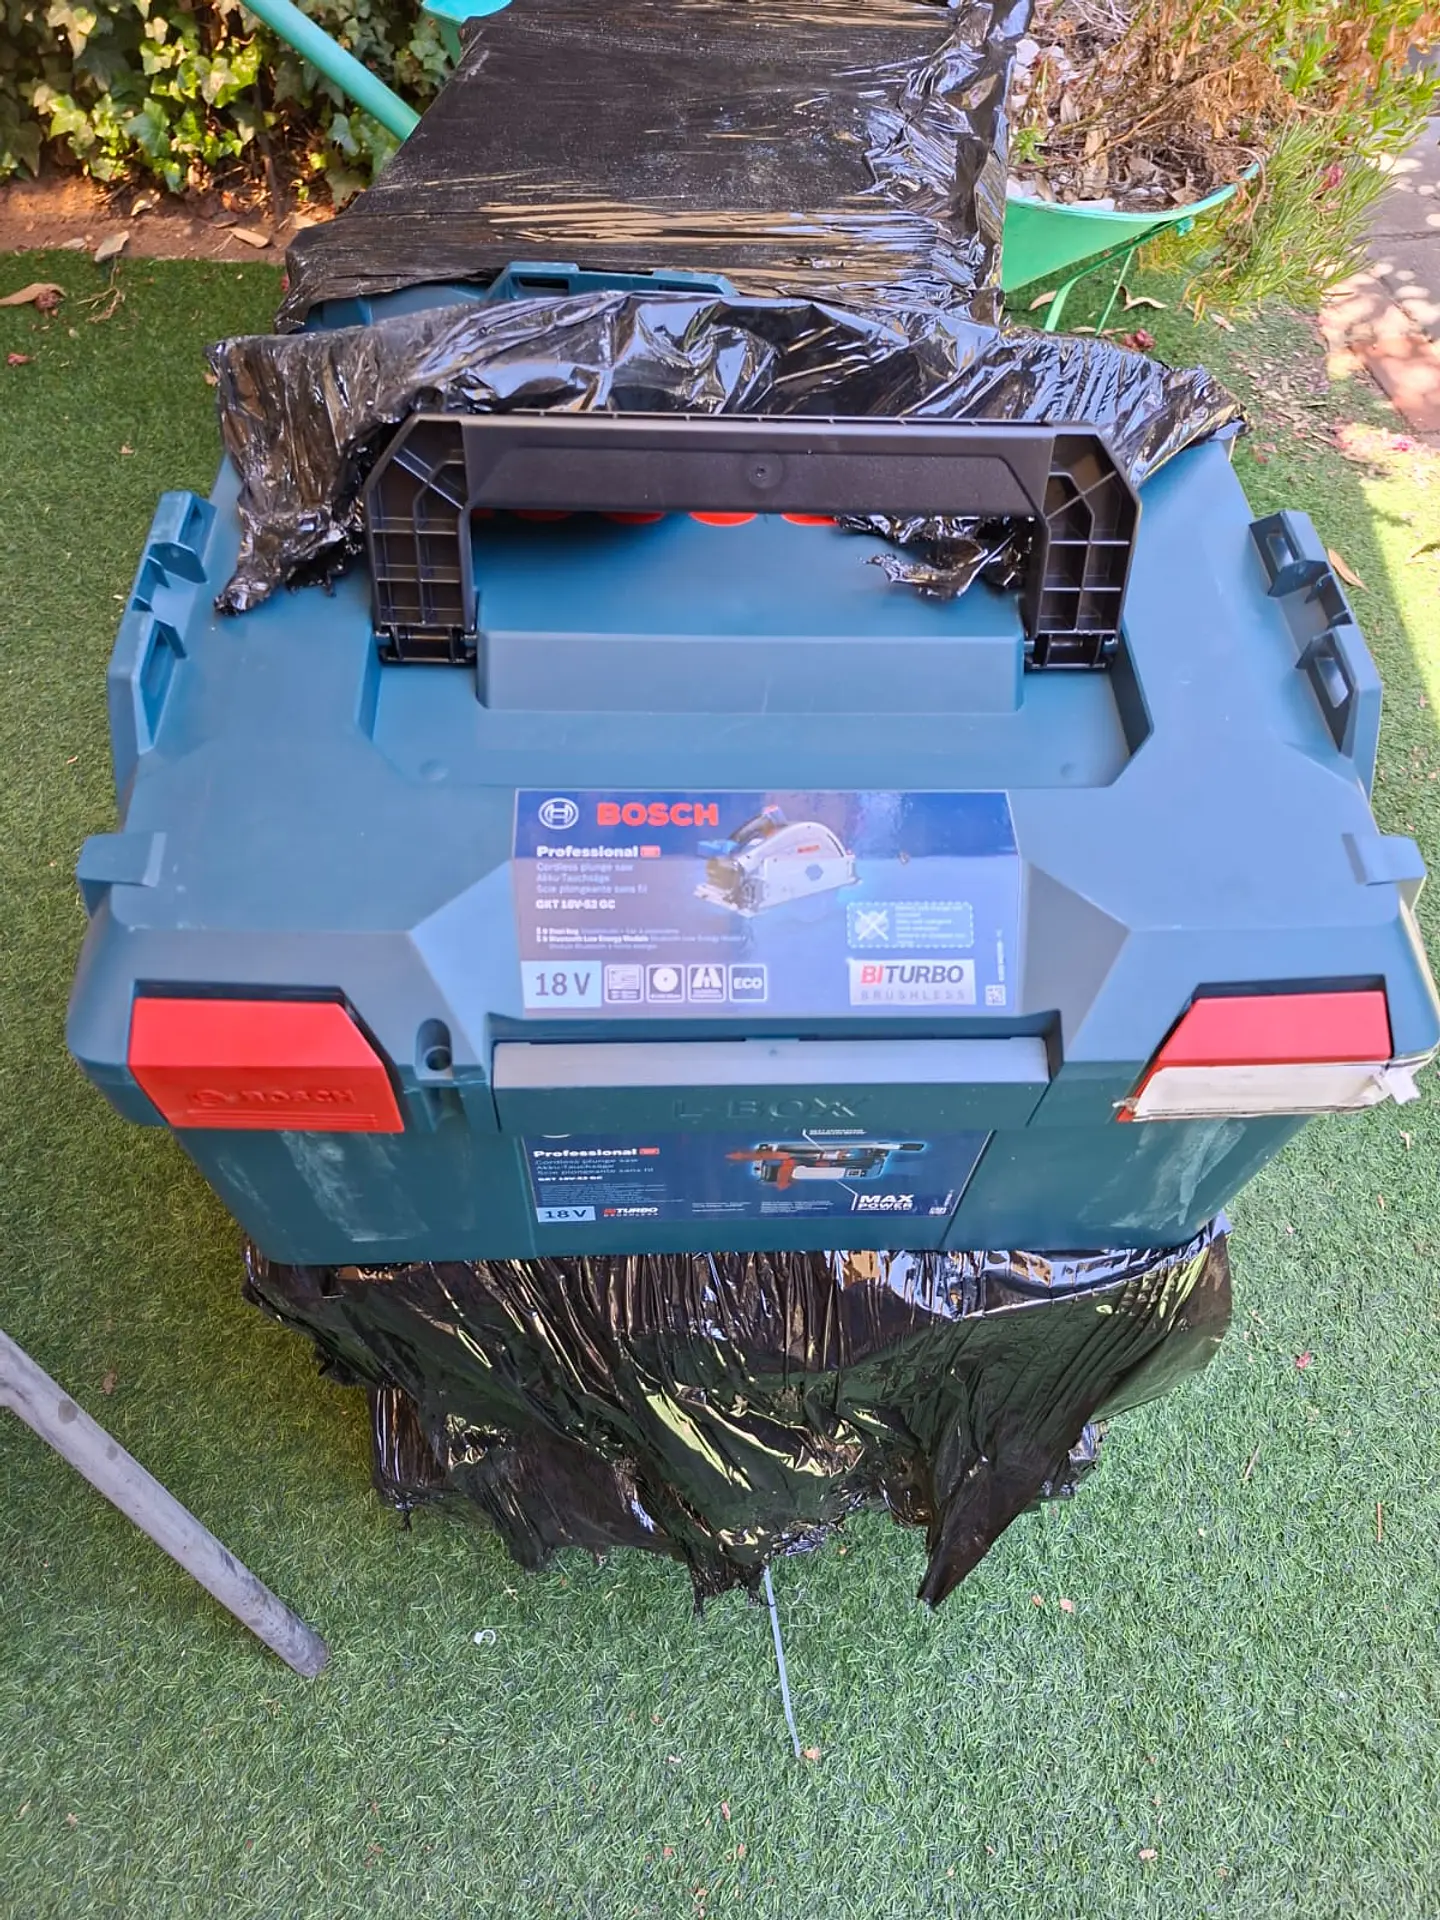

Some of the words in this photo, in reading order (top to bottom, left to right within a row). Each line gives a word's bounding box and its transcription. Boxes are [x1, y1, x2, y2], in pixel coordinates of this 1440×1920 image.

[596, 802, 719, 827] BOSCH
[536, 845, 638, 858] Professional
[861, 965, 964, 984] BITURBO
[535, 972, 567, 996] 18
[573, 972, 591, 996] V
[733, 977, 763, 990] ECO
[861, 990, 965, 1000] BRUSHLESS
[533, 1148, 637, 1158] Professional
[860, 1194, 915, 1203] MAX
[857, 1202, 914, 1211] POWER
[545, 1209, 570, 1219] 18
[572, 1208, 588, 1219] V
